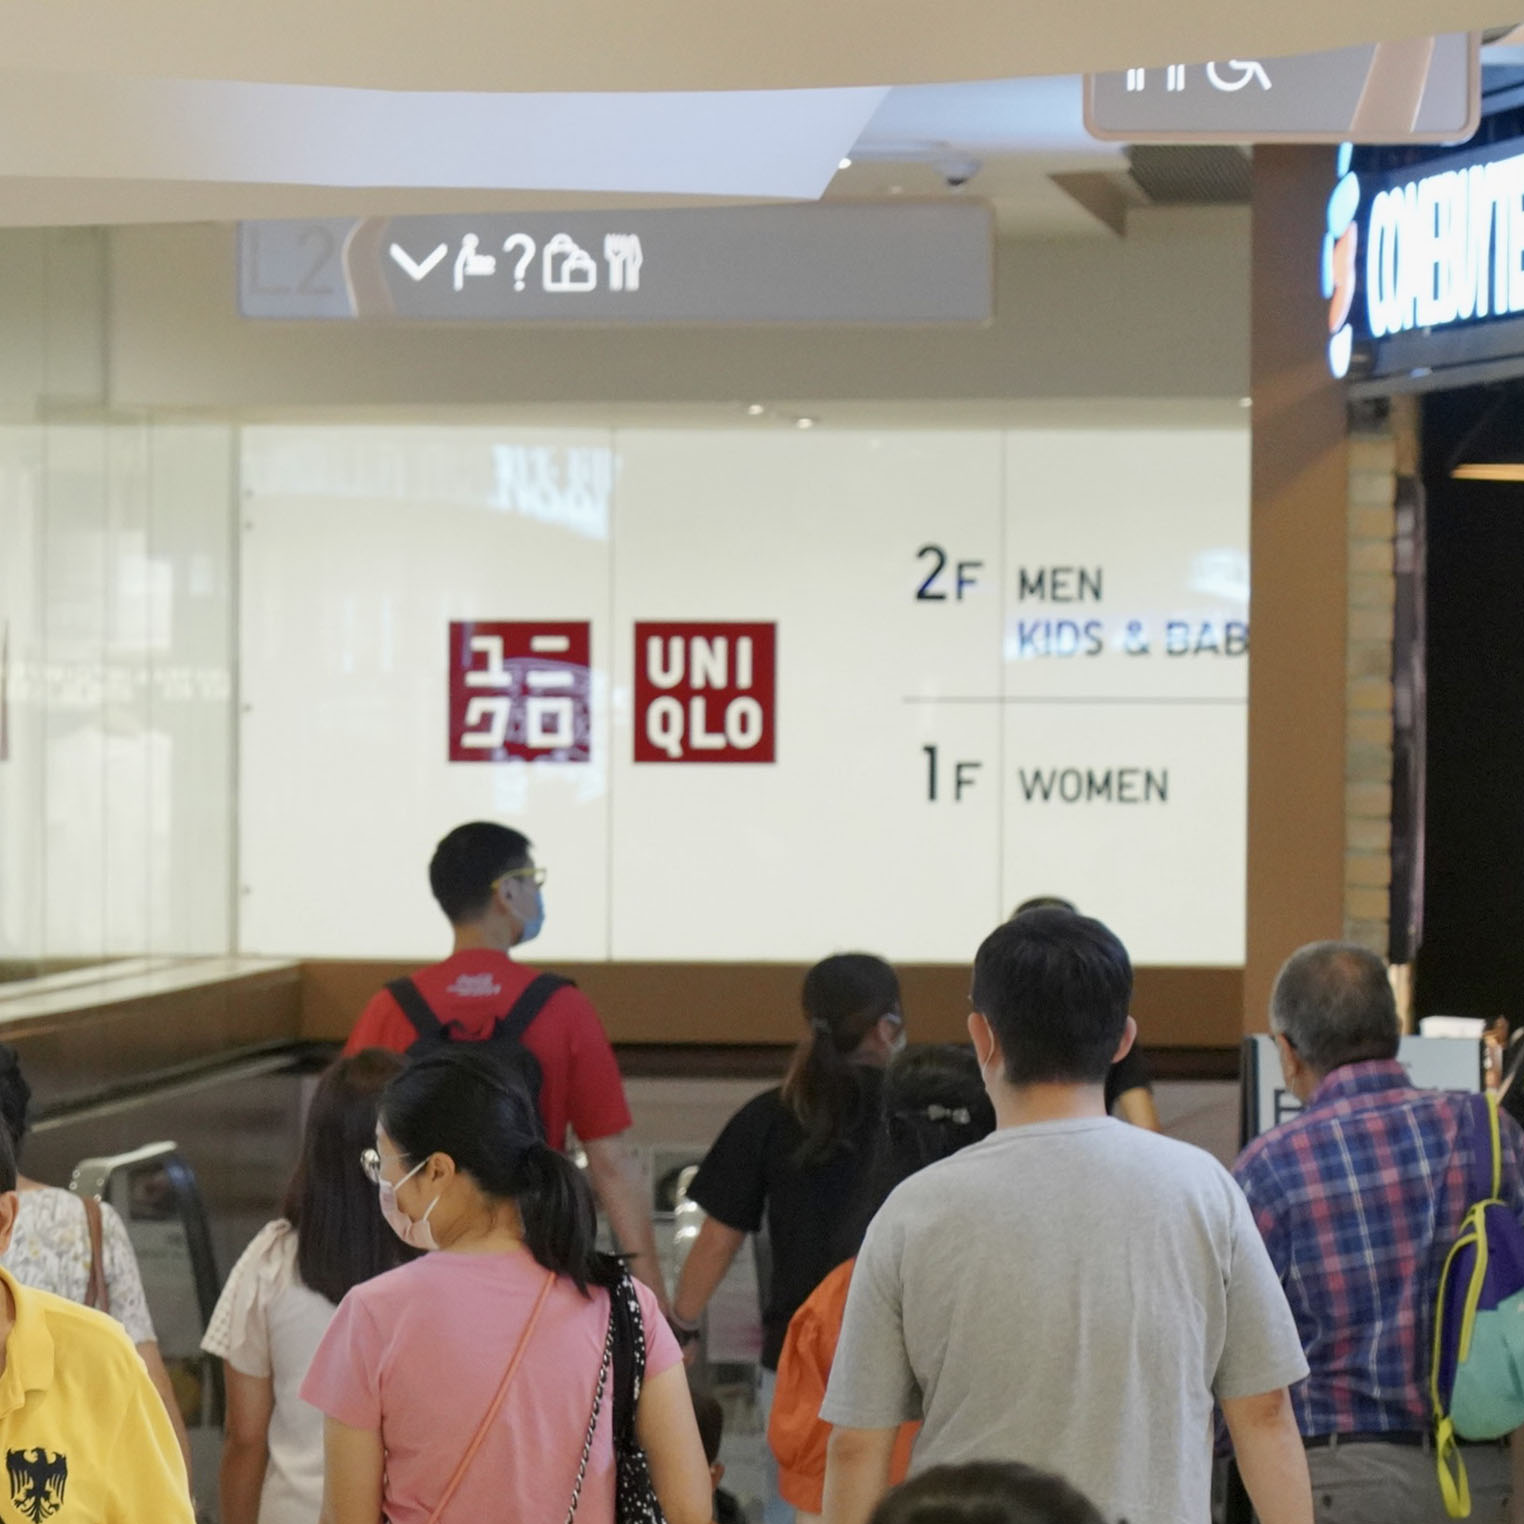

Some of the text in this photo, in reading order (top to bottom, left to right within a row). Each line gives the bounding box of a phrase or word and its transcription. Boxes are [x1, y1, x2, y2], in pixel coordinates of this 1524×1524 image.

[915, 544, 1103, 601] 2F MEN
[646, 635, 752, 690] UNI
[1017, 619, 1249, 656] KIDS & BAB
[646, 696, 763, 759] QLO
[921, 744, 1169, 802] 1F WOMEN
